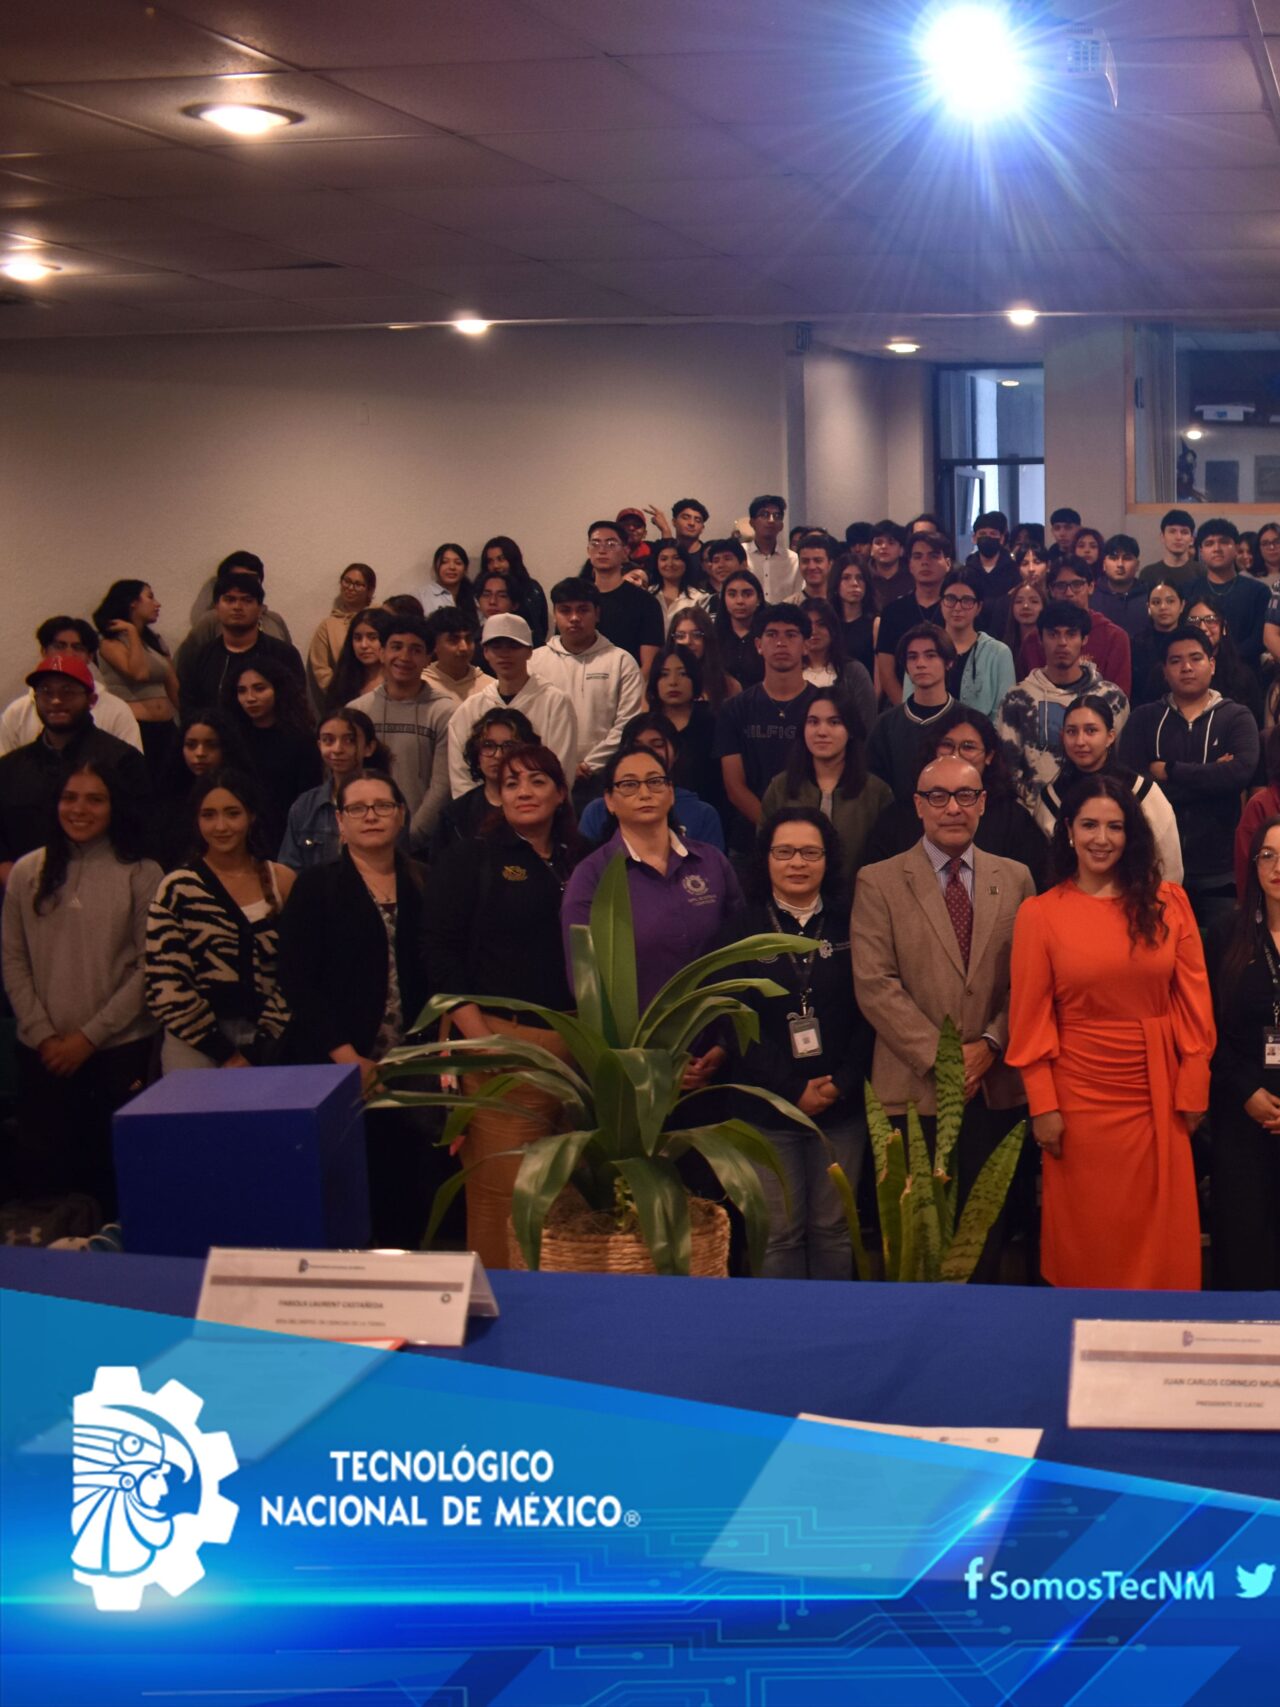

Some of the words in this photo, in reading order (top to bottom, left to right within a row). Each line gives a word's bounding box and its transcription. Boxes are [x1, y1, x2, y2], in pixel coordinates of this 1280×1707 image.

[1163, 1378, 1185, 1386] JUAN
[1187, 1378, 1218, 1387] CARLOS
[1220, 1379, 1258, 1388] CORNEJO
